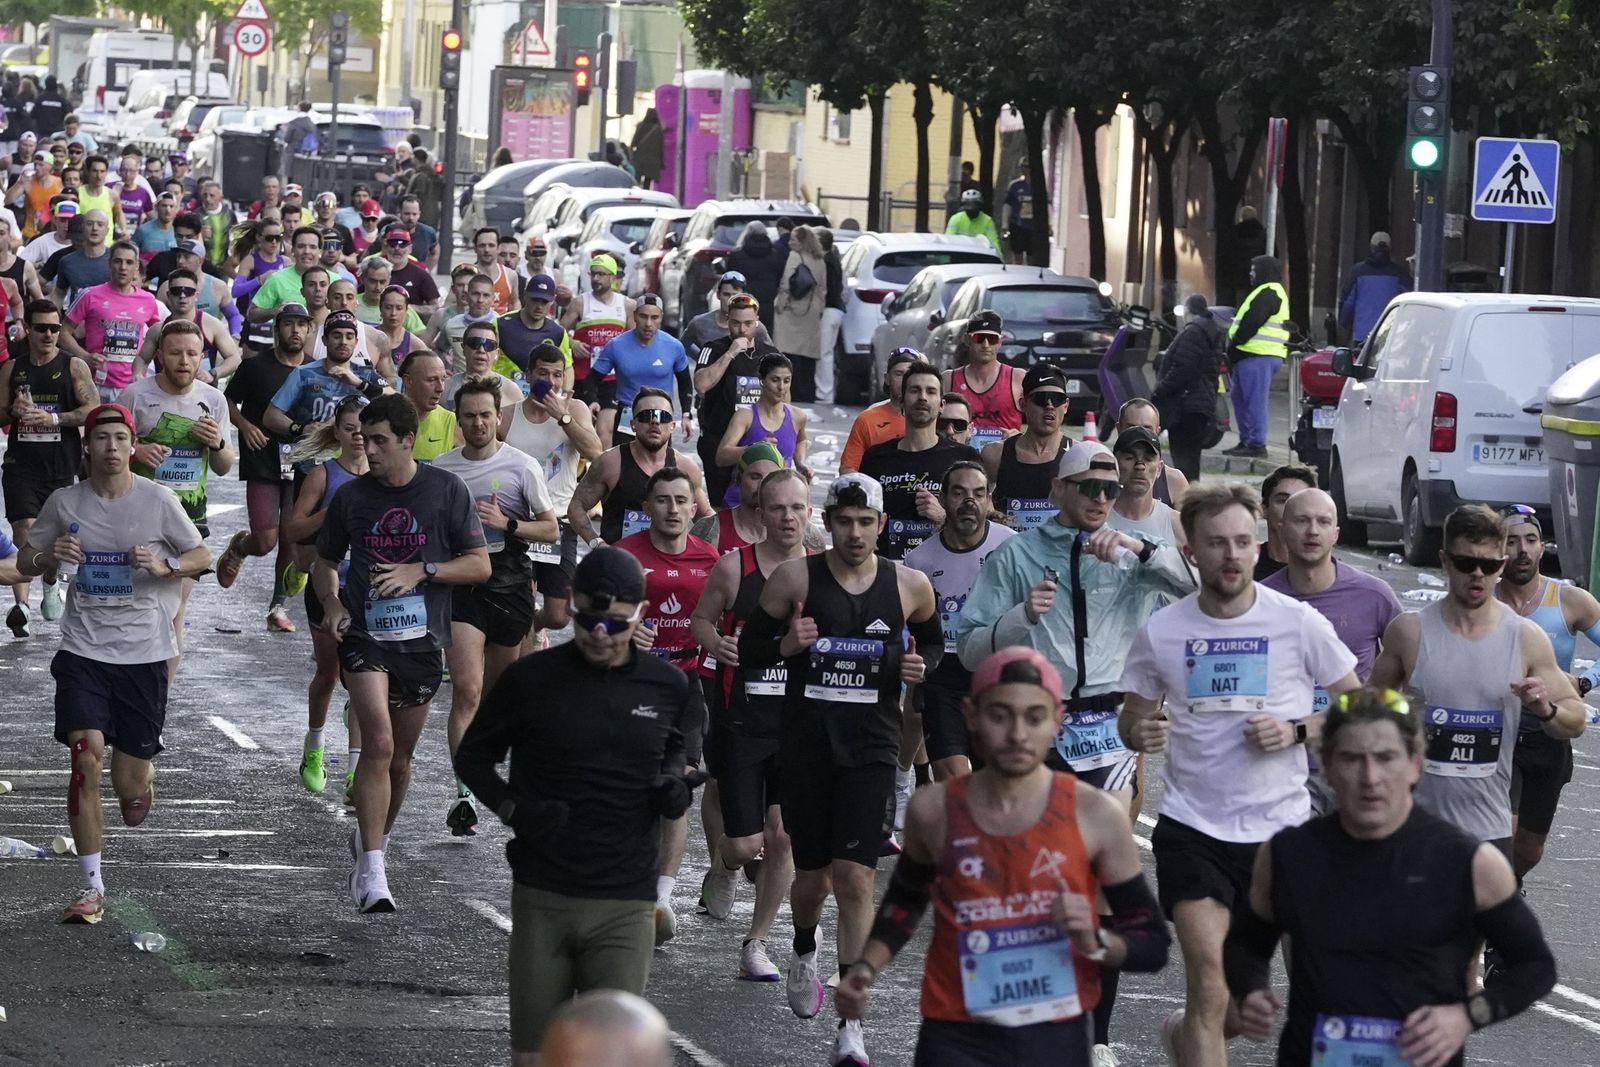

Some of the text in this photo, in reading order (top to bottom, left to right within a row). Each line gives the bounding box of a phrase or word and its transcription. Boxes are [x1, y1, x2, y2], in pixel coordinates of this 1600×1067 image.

[241, 32, 262, 45] 30
[175, 449, 200, 457] ZURICH
[1481, 447, 1545, 462] 9177 MFY
[161, 470, 195, 482] NUGGET
[879, 472, 917, 486] Sports
[1024, 501, 1055, 510] ZURICH
[906, 522, 936, 532] ZURICH
[363, 533, 429, 548] TRIASTUR
[907, 537, 923, 546] 4358
[90, 554, 125, 563] ZURICH
[386, 604, 405, 613] 5796
[374, 615, 418, 629] HEIYMA
[836, 642, 876, 653] ZURICH
[1213, 641, 1259, 651] ZURICH
[835, 661, 857, 670] 4650
[1214, 663, 1237, 673] 6801
[762, 669, 788, 681] JAVI
[822, 672, 865, 688] PAOLO
[1211, 677, 1240, 693] NAT
[1452, 714, 1495, 724] ZURICH
[1451, 734, 1476, 744] 4923
[1064, 737, 1122, 759] MICHAEL
[1449, 747, 1474, 761] ALI
[994, 926, 1057, 946] ZURICH
[990, 975, 1055, 1004] JAIME
